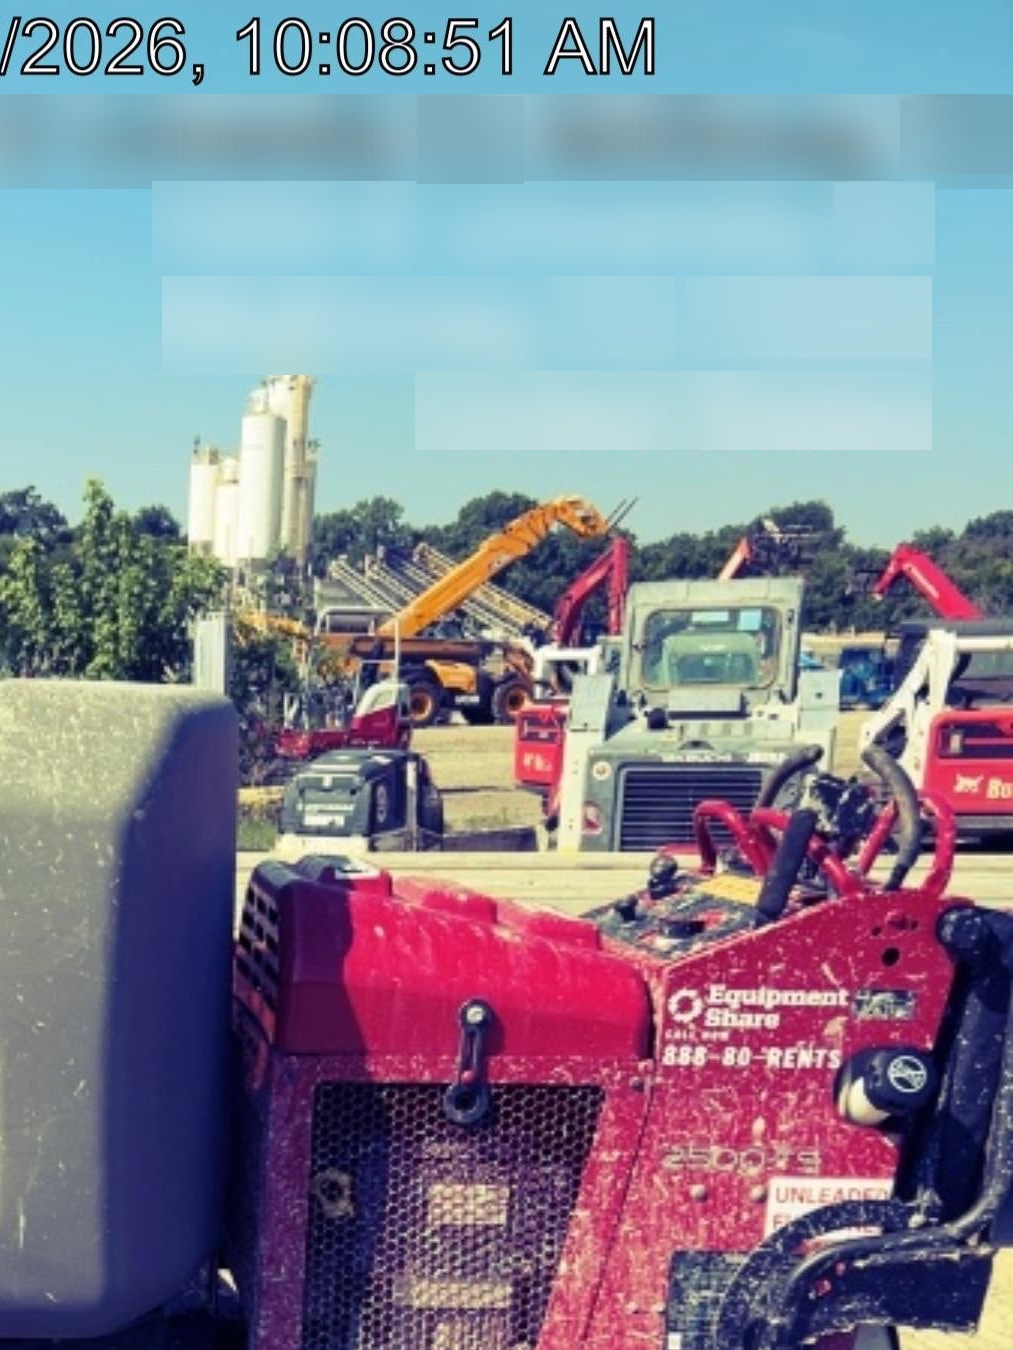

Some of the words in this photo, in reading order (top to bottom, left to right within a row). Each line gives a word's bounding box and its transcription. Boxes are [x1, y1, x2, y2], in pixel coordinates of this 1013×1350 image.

[708, 984, 849, 1008] Equipment
[705, 1008, 780, 1028] Share
[776, 1186, 889, 1204] UNLEADED
